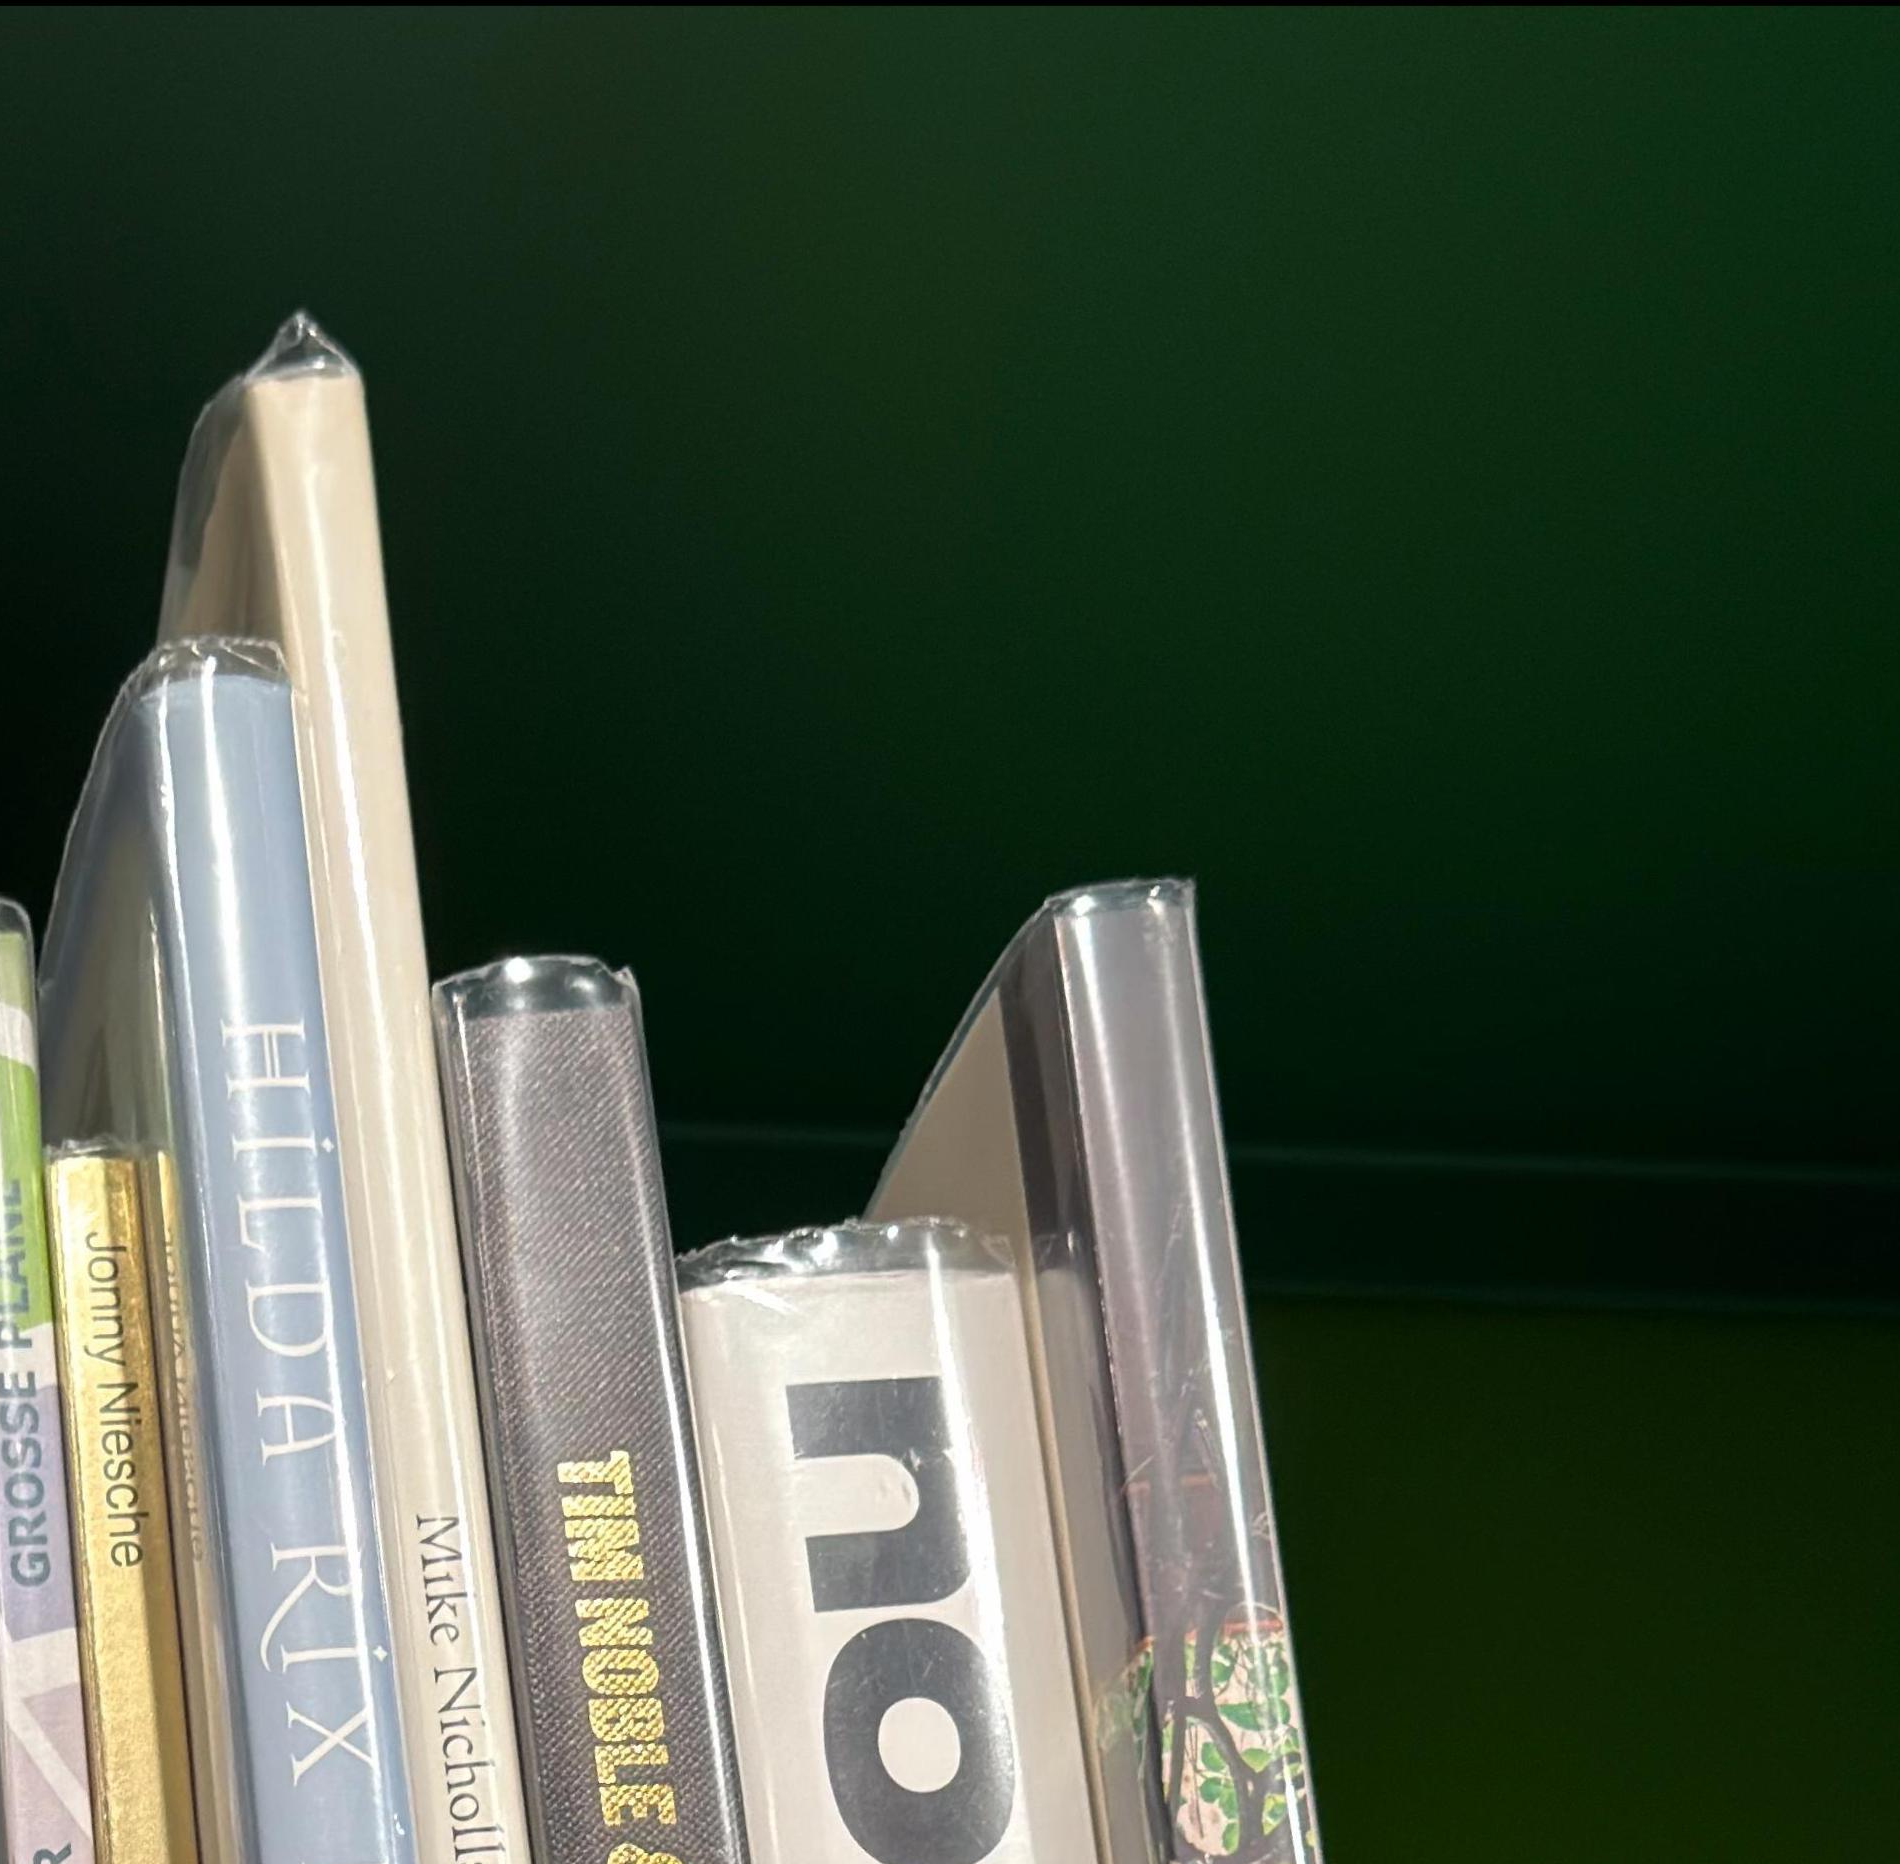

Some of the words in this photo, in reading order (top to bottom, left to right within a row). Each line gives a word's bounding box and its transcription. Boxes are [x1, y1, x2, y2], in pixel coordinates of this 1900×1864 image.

[83, 1230, 127, 1371] Jonny
[97, 1380, 144, 1569] Niesche
[557, 1450, 645, 1582] TIM
[416, 1512, 479, 1646] Mike
[575, 1598, 679, 1827] NOBLE
